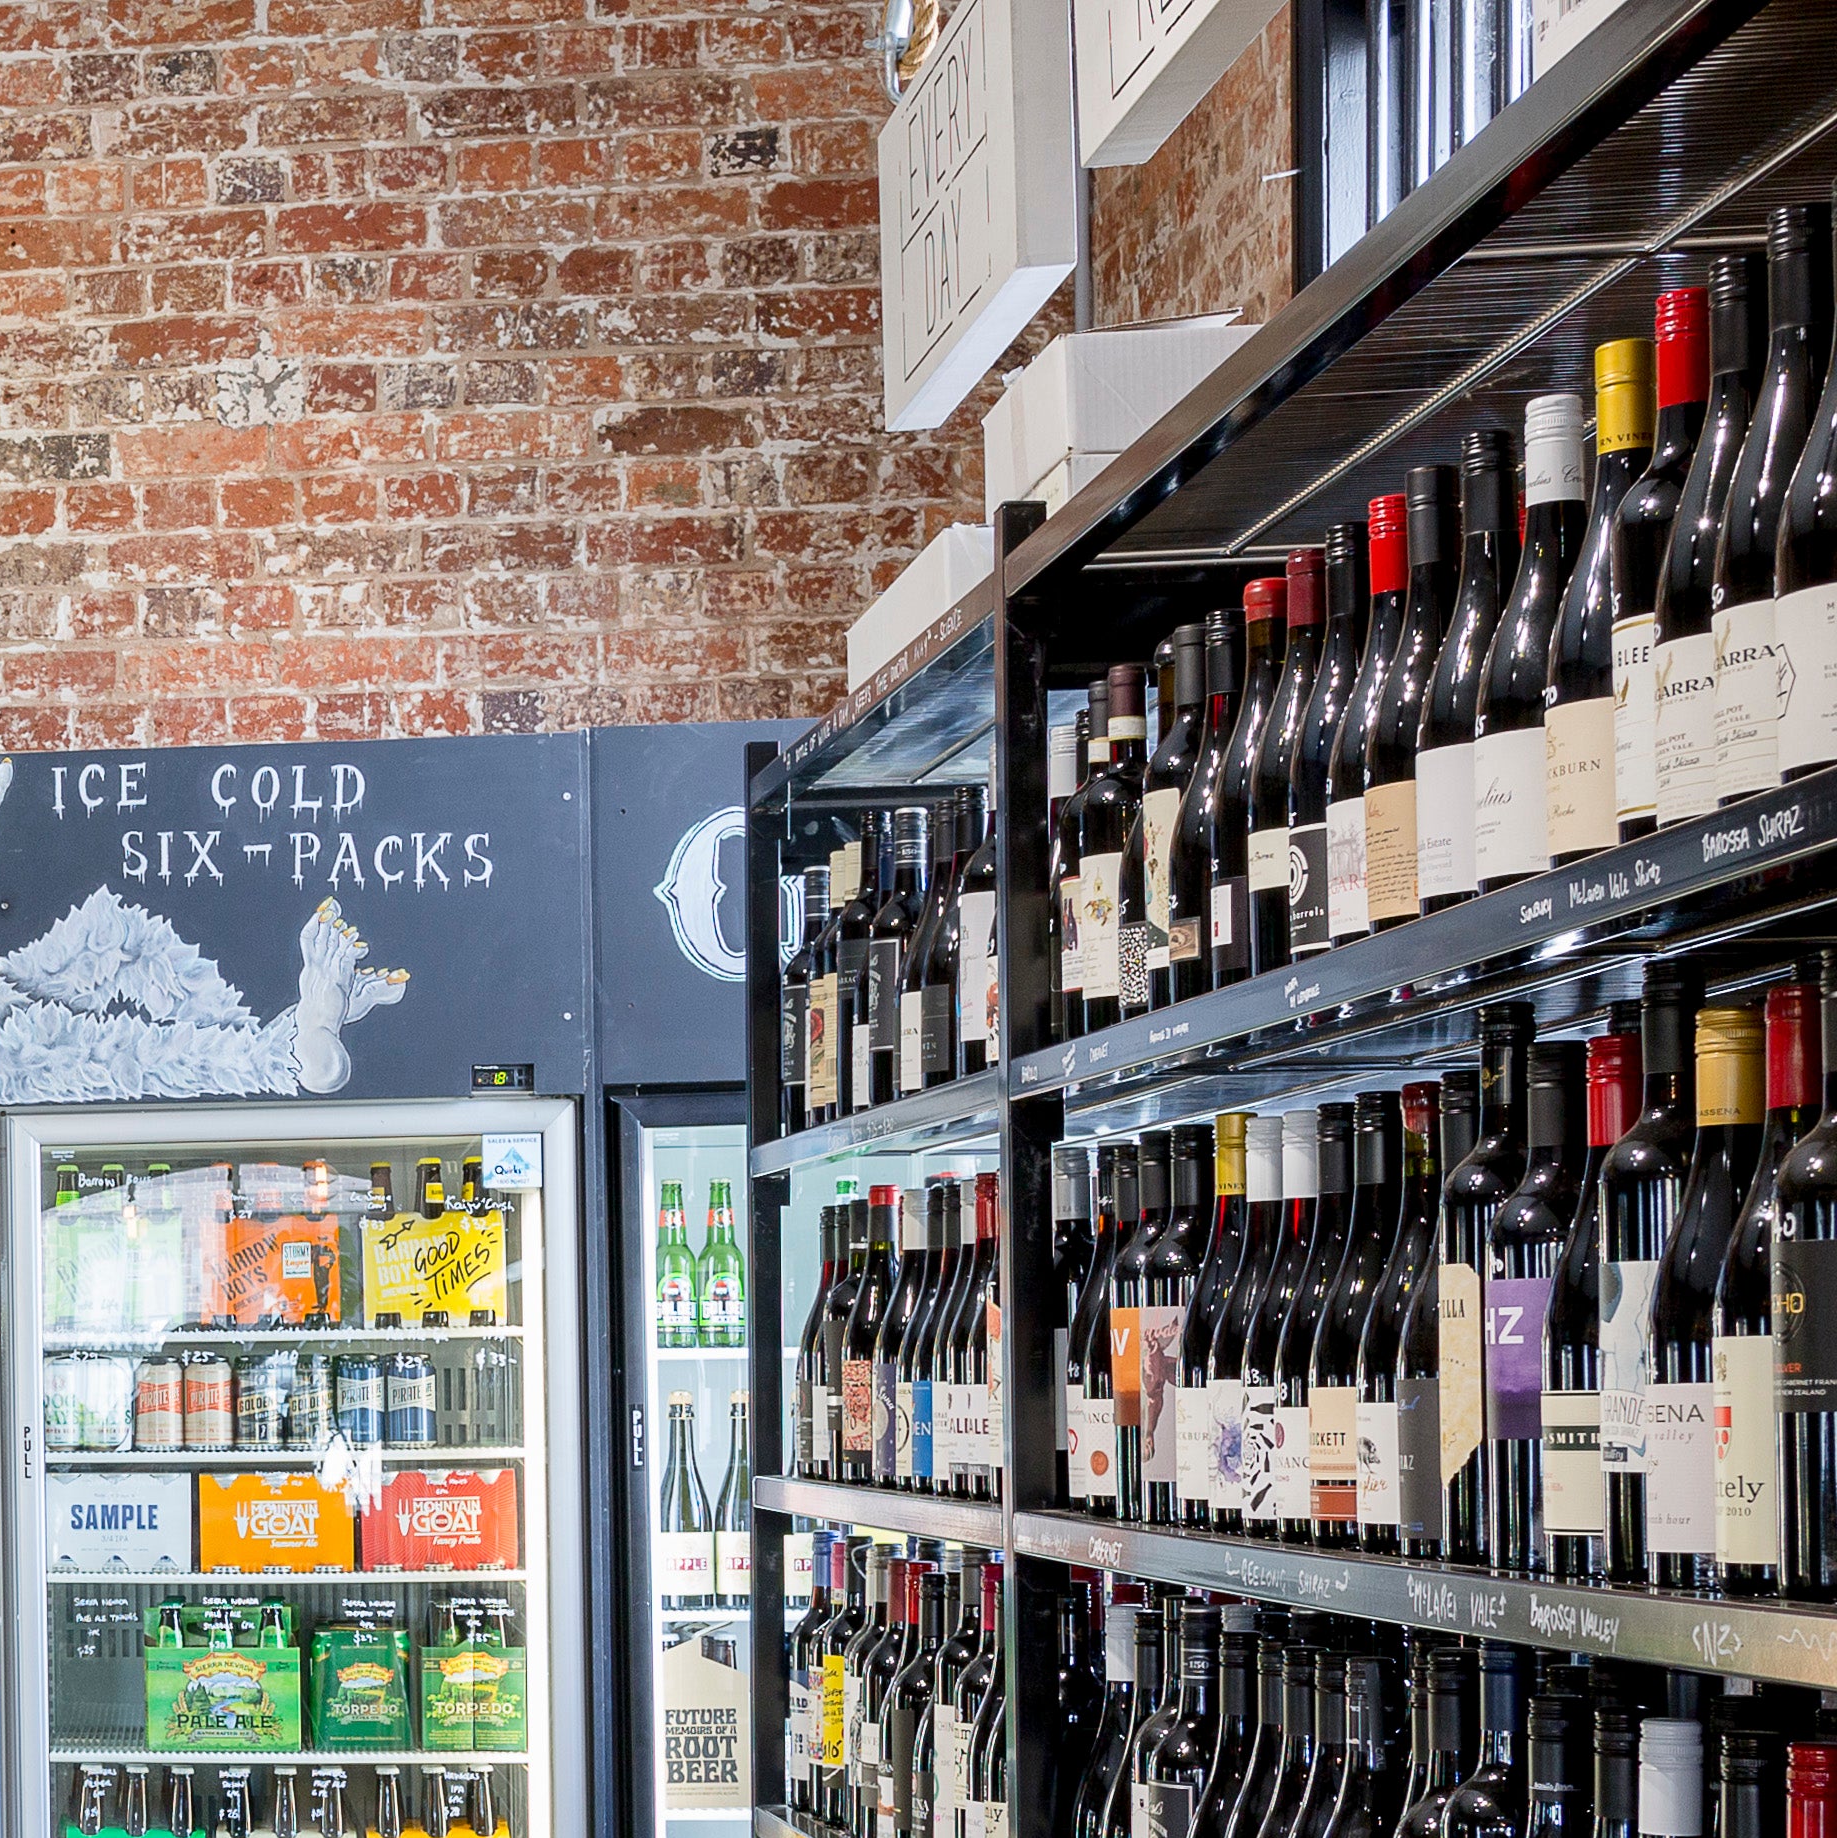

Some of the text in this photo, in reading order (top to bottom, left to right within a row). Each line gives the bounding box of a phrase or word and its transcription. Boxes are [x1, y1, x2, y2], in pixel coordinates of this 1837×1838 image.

[908, 27, 971, 220] EVERY
[925, 188, 961, 336] DAY
[52, 763, 366, 822] ICE COLD
[1702, 805, 1805, 863] BAROSSA SHIRAZ
[122, 831, 493, 891] SIX-PACKS
[414, 1230, 459, 1272] GOOD
[139, 1387, 168, 1405] PIRATE
[392, 1387, 420, 1403] PIRATE
[631, 1408, 643, 1467] PULL
[23, 1426, 31, 1478] PULL
[71, 1503, 159, 1530] SAMPLE
[251, 1502, 319, 1516] MOUNTAIN
[250, 1514, 319, 1535] GOAT
[413, 1511, 480, 1533] GOAT
[665, 1557, 708, 1571] APPLE
[1241, 1557, 1332, 1599] GEELONG SHIRAZ
[1530, 1593, 1620, 1653] BAROSSA VALLEY
[331, 1704, 398, 1718] TORPEDO
[434, 1702, 514, 1717] TORPEDO
[665, 1707, 737, 1725] FUTURE
[177, 1713, 273, 1730] PALE ALE
[665, 1725, 727, 1735] MEMOIRS OF
[665, 1736, 737, 1759] ROOT
[667, 1760, 738, 1784] BEER
